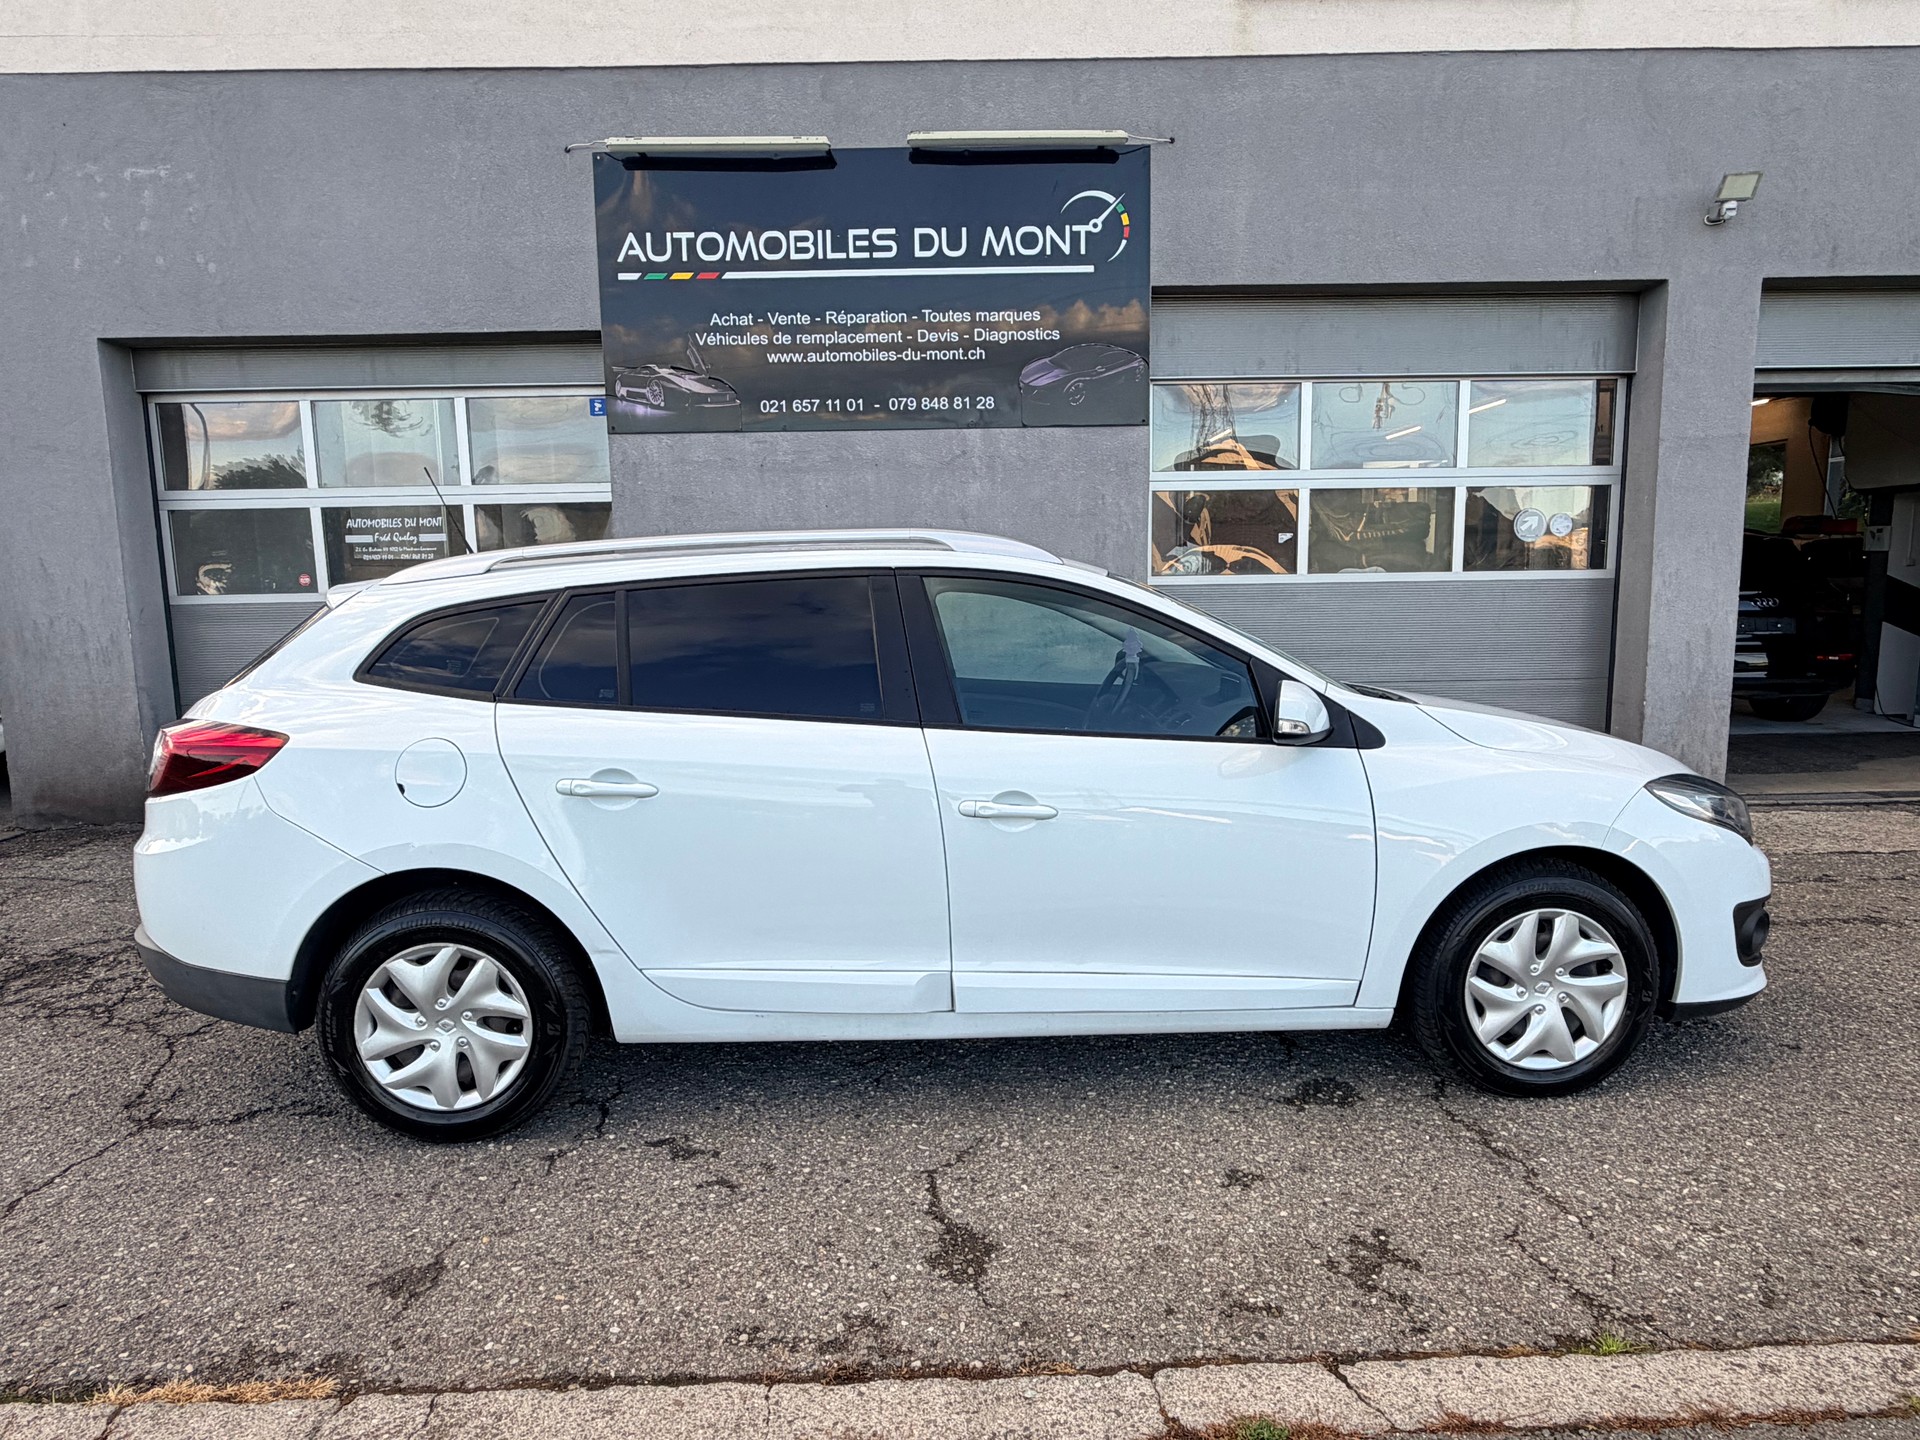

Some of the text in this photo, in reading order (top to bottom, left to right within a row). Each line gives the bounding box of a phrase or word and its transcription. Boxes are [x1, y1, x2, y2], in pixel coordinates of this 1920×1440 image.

[617, 224, 1092, 262] AUTOMOBILES DU MONT
[709, 312, 754, 327] Achat
[767, 311, 811, 325] Vente
[825, 310, 908, 327] Réparation
[921, 309, 971, 323] Toutes
[976, 311, 1042, 325] marques
[695, 331, 769, 346] Véhicules
[772, 331, 792, 345] de
[796, 330, 903, 348] remplacement
[917, 329, 960, 343] Devis
[973, 327, 1061, 344] Diagnostics
[766, 347, 986, 364] www.automobiles-du-mont.ch
[760, 399, 787, 413] 021
[792, 398, 821, 413] 657
[825, 399, 840, 412] 11
[846, 398, 864, 412] 01
[888, 397, 917, 411] 079
[921, 396, 949, 411] 848
[953, 396, 970, 410] 81
[975, 395, 995, 410] 28
[346, 516, 443, 529] AUTOMOBILES DU MONT
